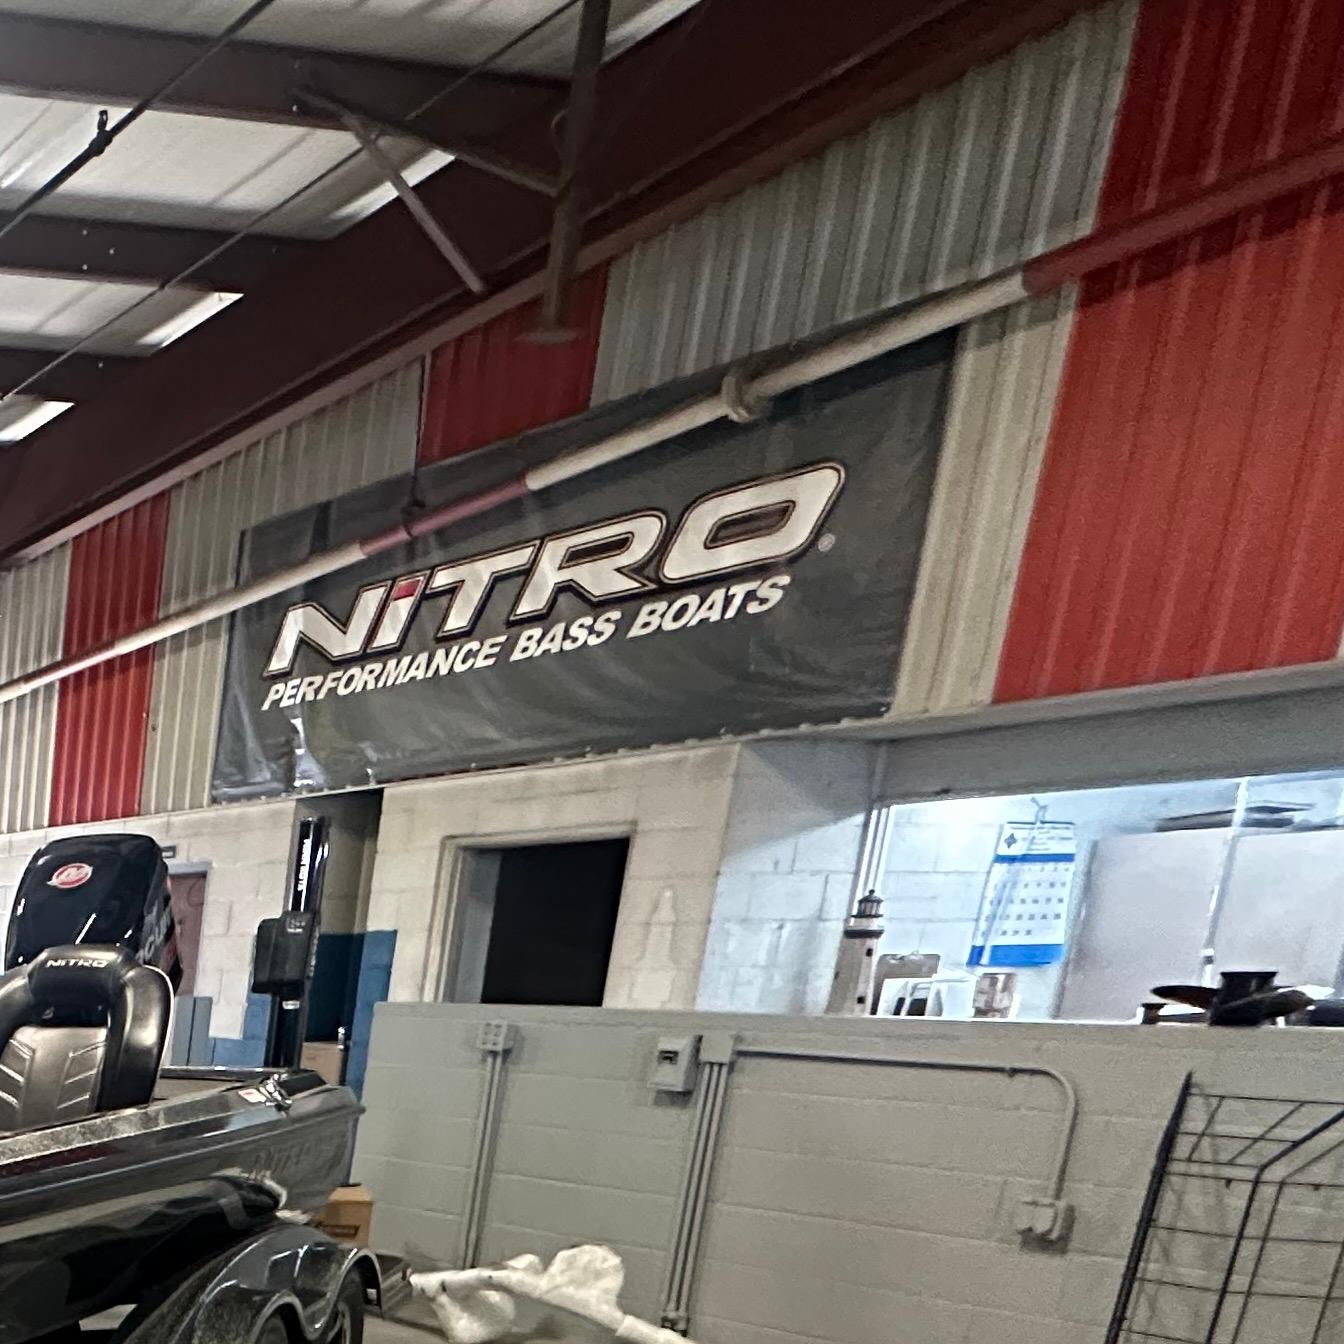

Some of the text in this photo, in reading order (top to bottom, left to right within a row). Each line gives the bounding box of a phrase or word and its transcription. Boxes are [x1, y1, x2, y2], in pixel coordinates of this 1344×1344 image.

[262, 575, 791, 710] PERFORMANCE BASS BOATS
